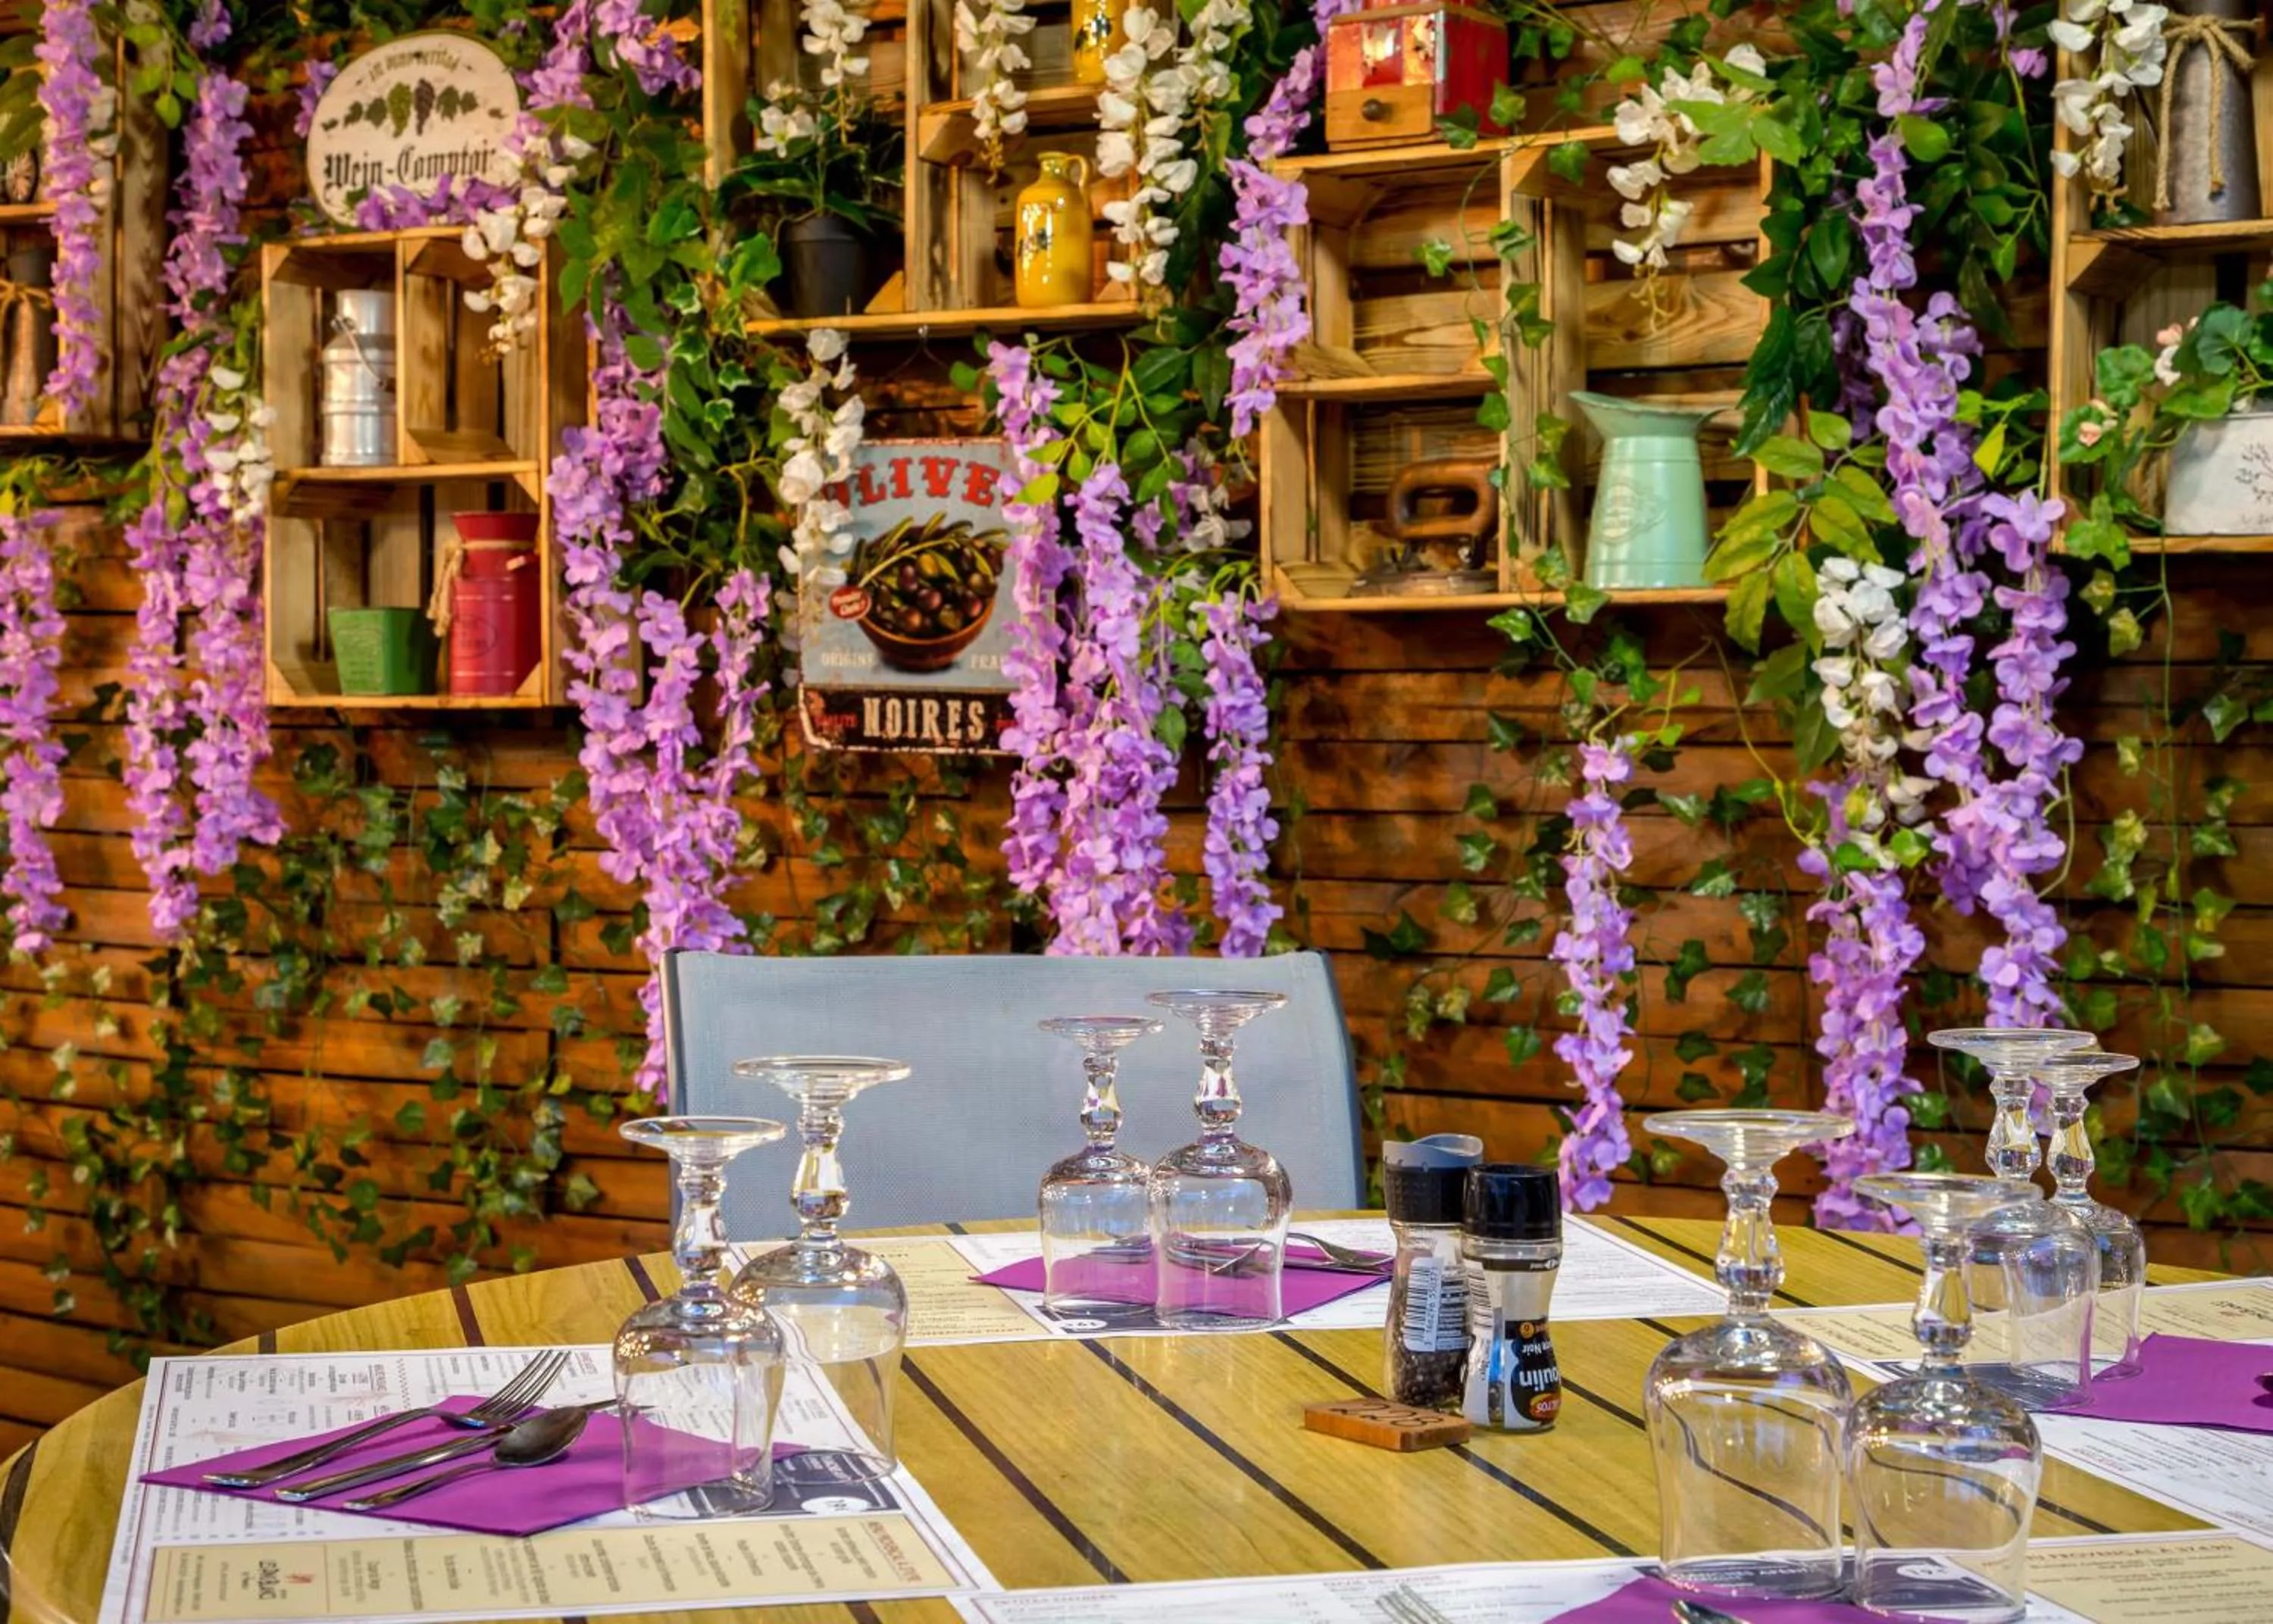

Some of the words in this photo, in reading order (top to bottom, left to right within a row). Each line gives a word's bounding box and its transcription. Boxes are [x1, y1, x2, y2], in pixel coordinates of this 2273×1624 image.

[823, 456, 1014, 510] LIVE
[970, 653, 1004, 670] FRA
[863, 697, 985, 742] NOIRES
[1522, 1340, 1543, 1356] Noir
